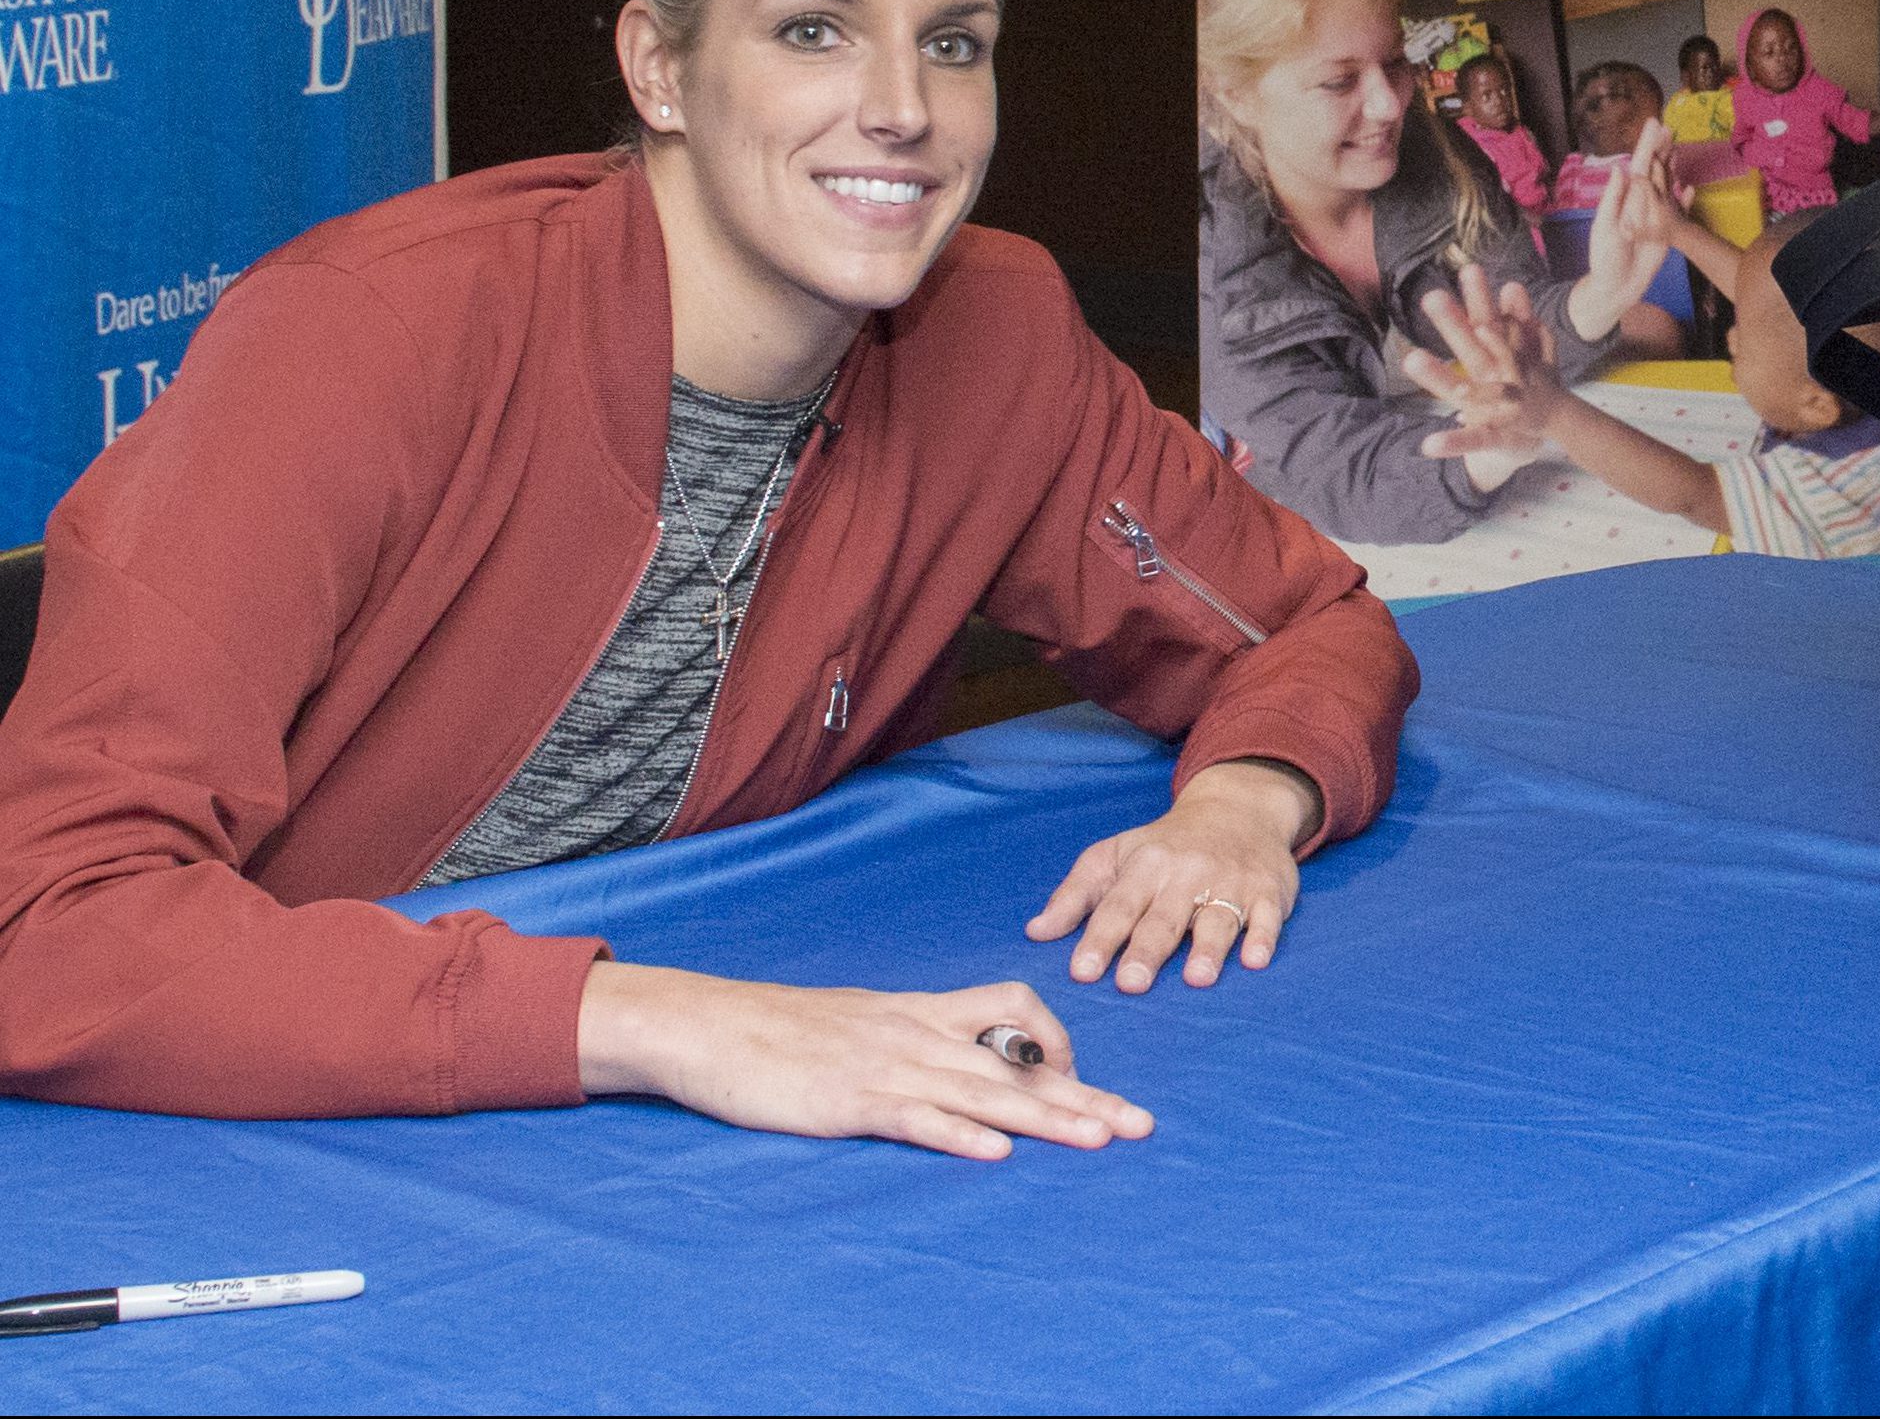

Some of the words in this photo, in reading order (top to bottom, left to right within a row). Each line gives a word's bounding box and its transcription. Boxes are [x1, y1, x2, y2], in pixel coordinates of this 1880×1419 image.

[96, 291, 154, 337] Dare
[157, 285, 182, 323] to
[182, 272, 208, 317] be
